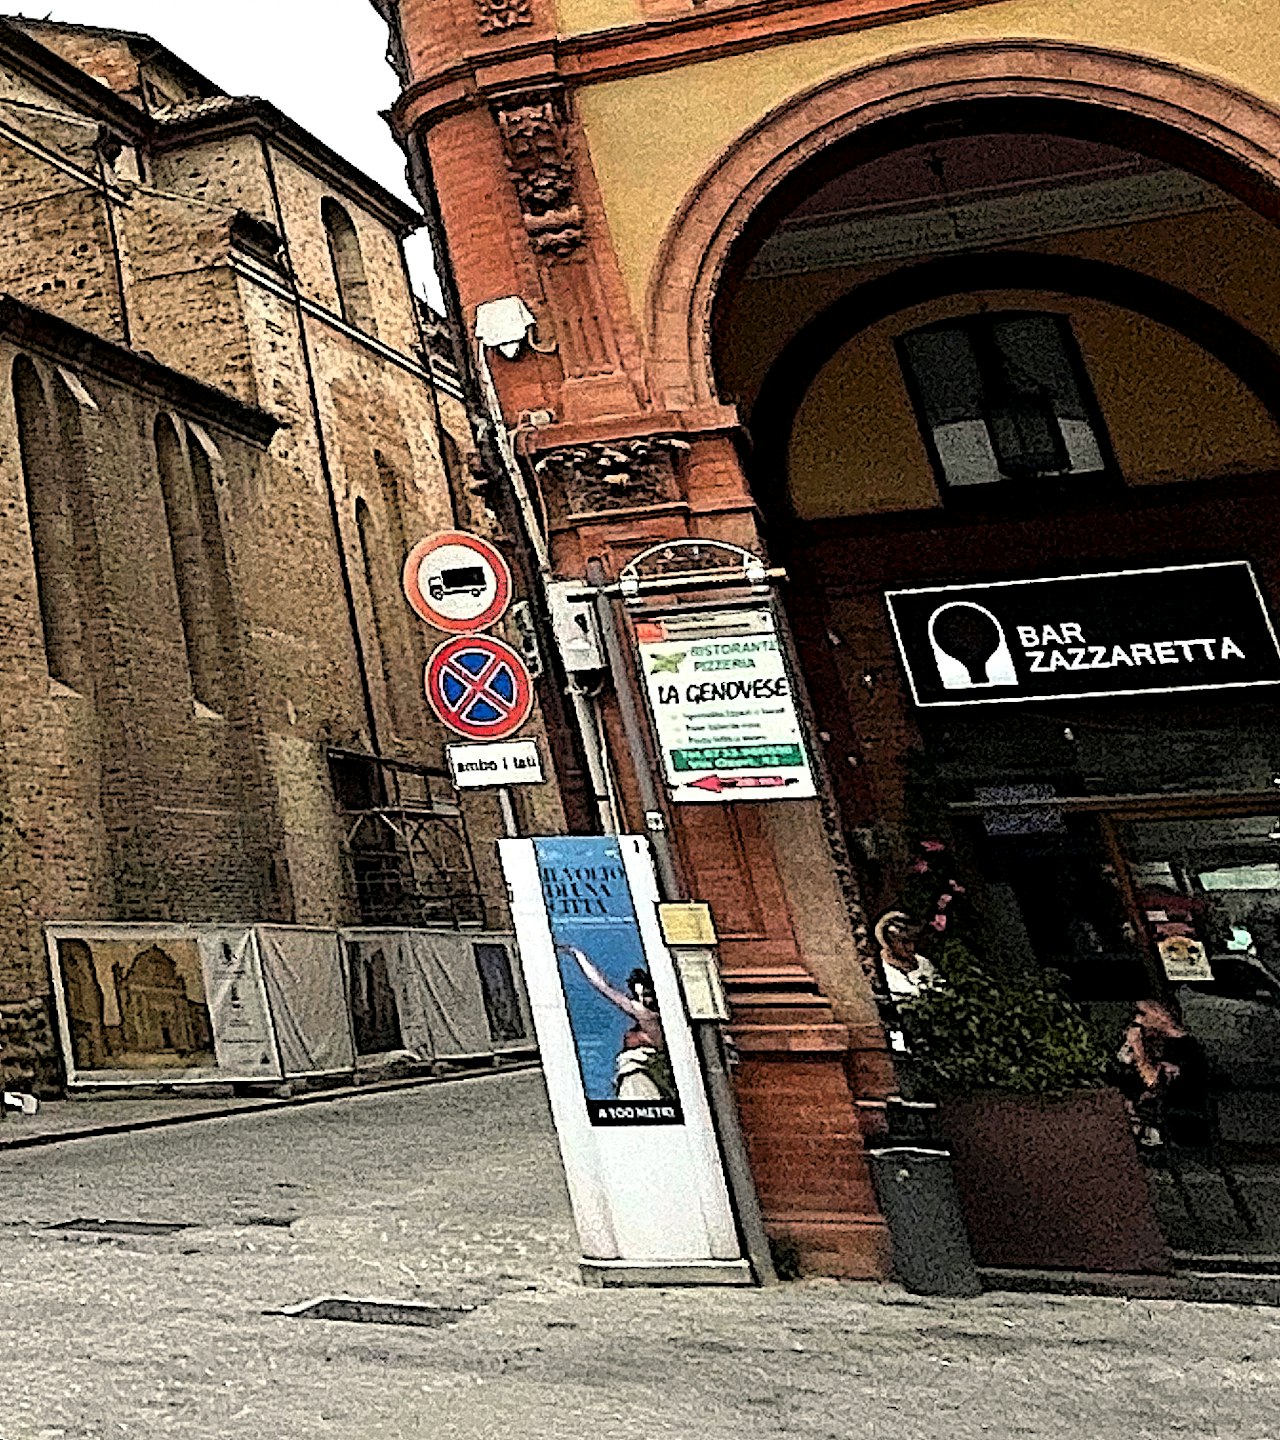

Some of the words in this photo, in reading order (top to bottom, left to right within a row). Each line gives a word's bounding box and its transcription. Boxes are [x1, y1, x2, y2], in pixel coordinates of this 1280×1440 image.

[1017, 623, 1086, 648] BAR
[1025, 637, 1246, 672] ZAZZARETTA
[658, 684, 680, 705] LA
[686, 677, 789, 704] GENOVESE
[457, 759, 498, 772] ambo
